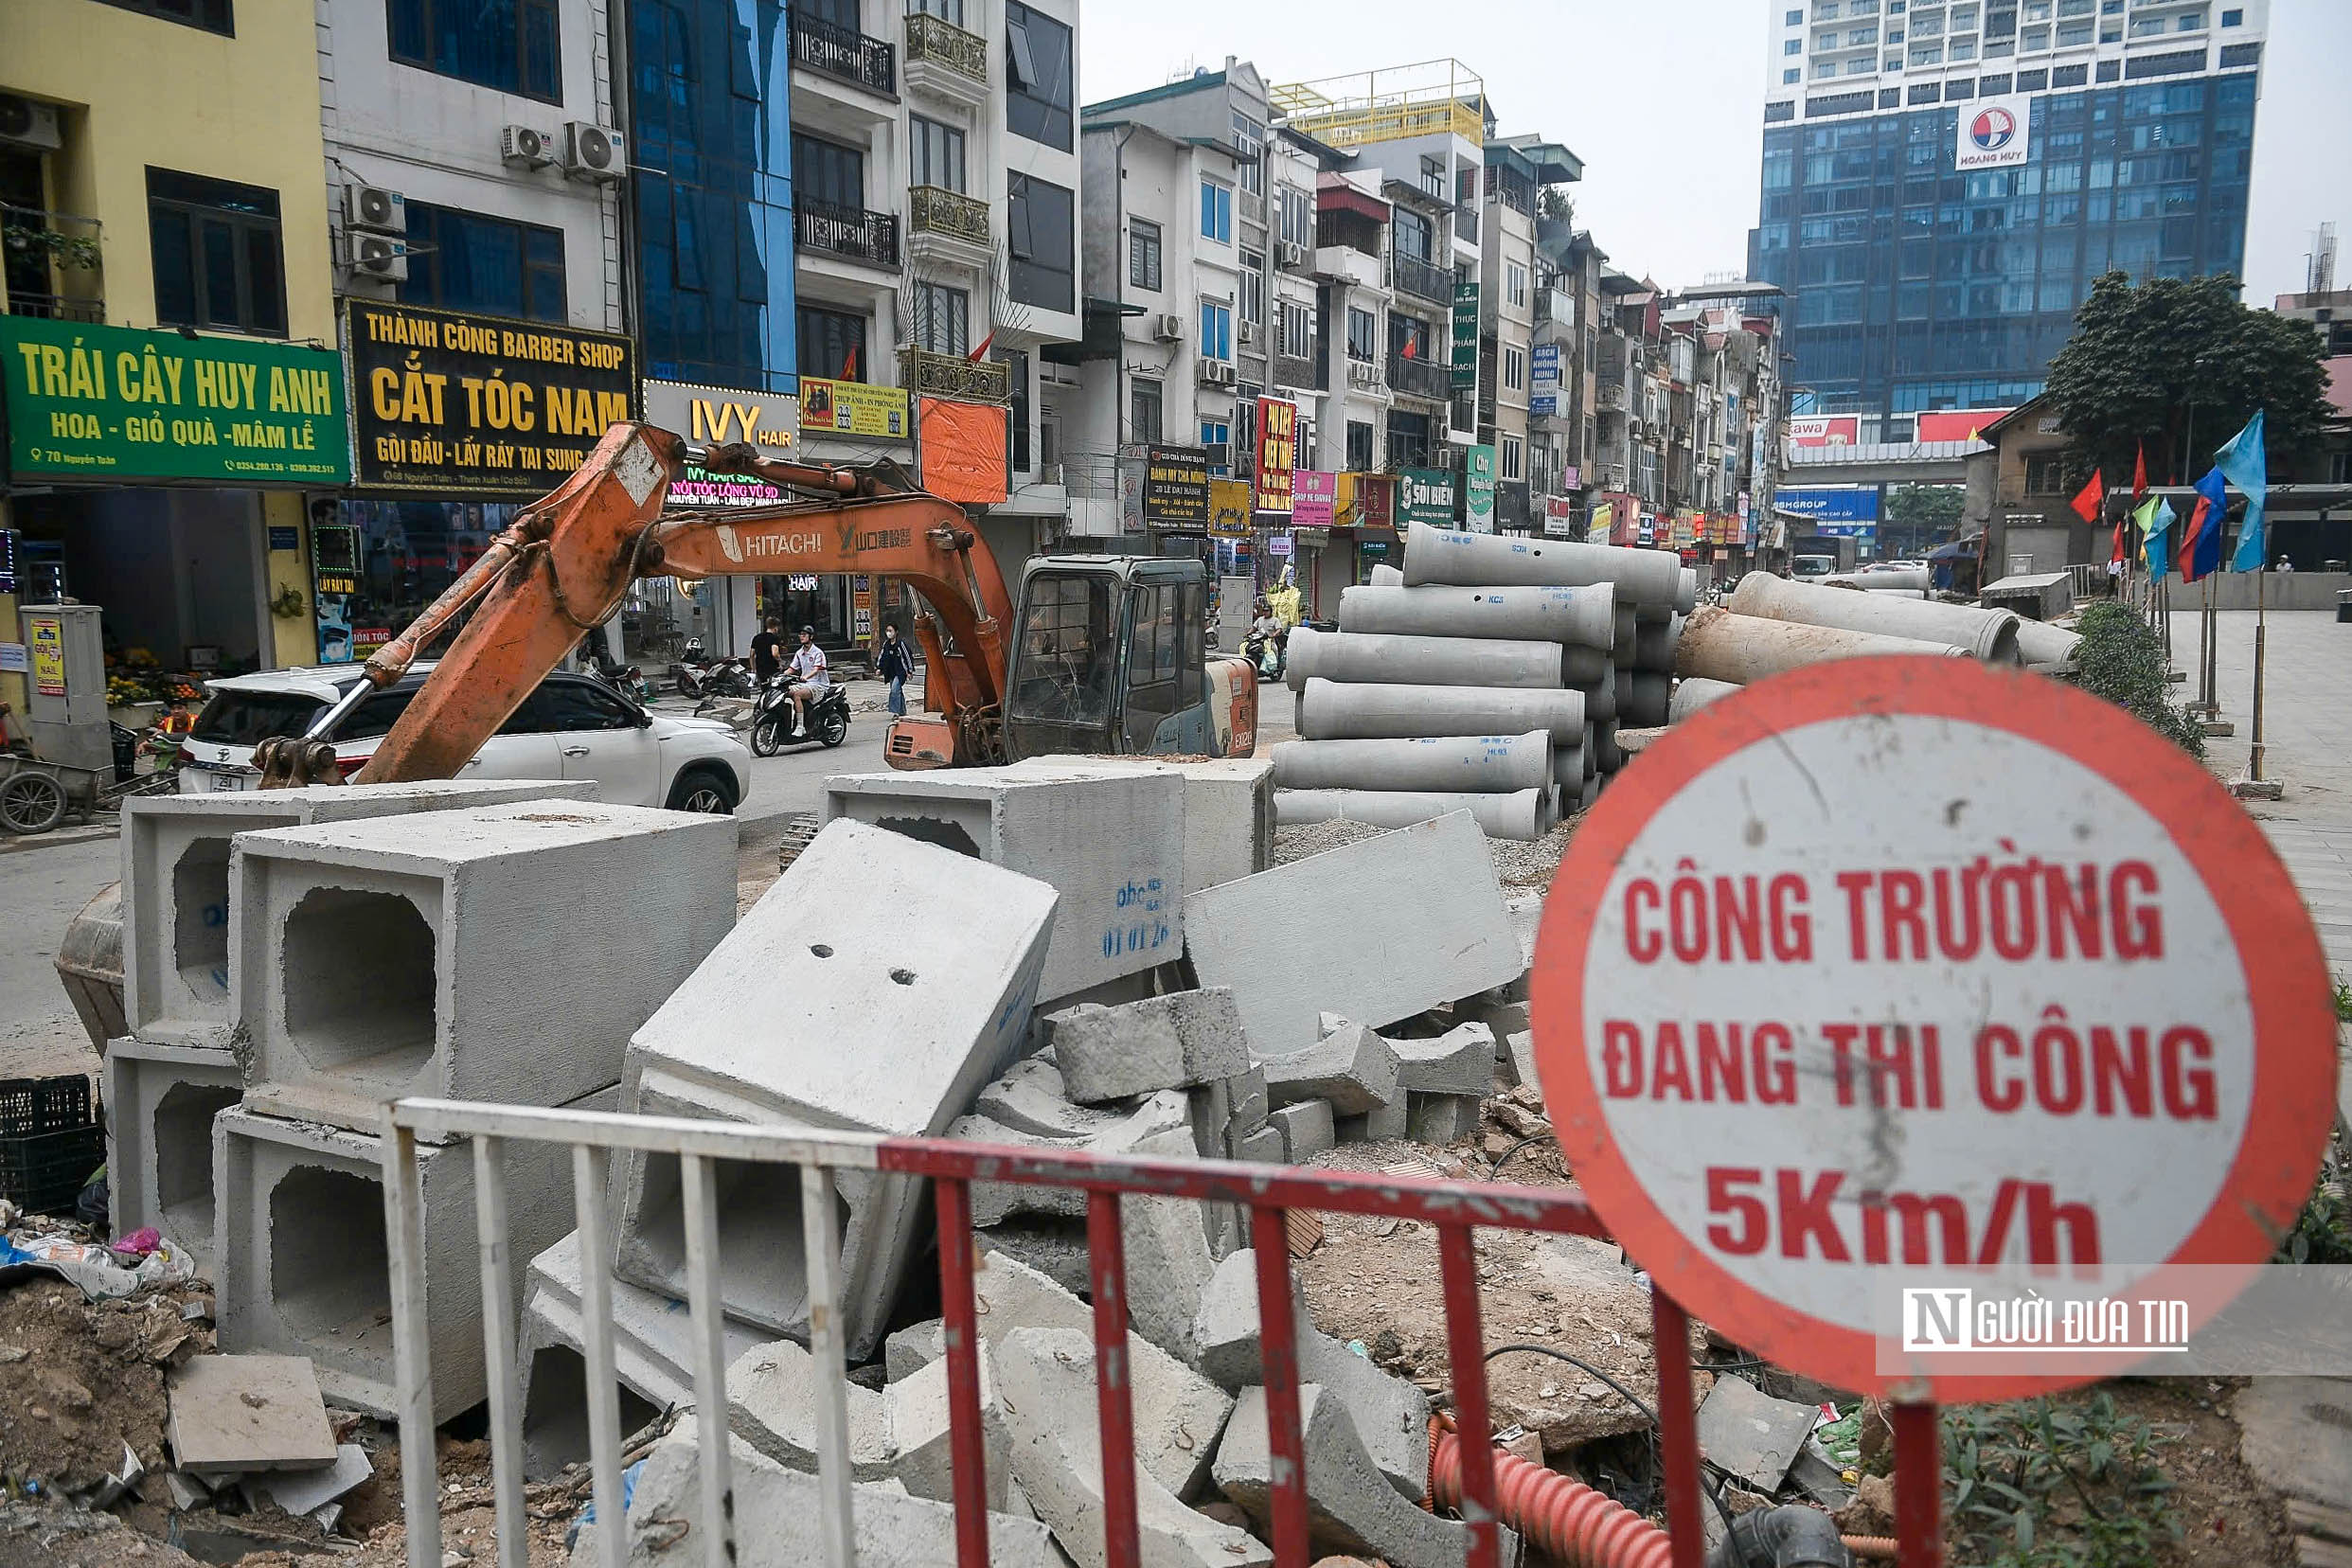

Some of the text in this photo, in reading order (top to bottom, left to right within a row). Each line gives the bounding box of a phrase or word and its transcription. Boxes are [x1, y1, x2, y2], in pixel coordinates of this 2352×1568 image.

[2000, 151, 2022, 161] HUY
[366, 312, 624, 370] THÀNH CÔNG BARBER SHOP
[18, 337, 331, 416] TRÁI CÂY HUY ANH
[371, 350, 628, 437] CẮT TÓC NAM
[50, 412, 101, 439] HOA
[125, 409, 165, 443] GIỎ
[172, 416, 218, 447] QUÀ
[292, 419, 314, 450] LỄ
[690, 399, 791, 448] IVY HAIR
[45, 450, 61, 463] 70
[377, 432, 406, 469] GỘI
[411, 432, 443, 465] ĐẦU
[519, 446, 542, 470] TAI
[687, 467, 705, 481] IVY
[765, 487, 779, 499] 9D
[1413, 478, 1430, 505] SÓI
[745, 532, 822, 557] HITACHI
[790, 576, 817, 591] HAIR
[1488, 596, 1504, 604] KCS
[1623, 838, 2165, 965] CÔNG TRƯỜNG
[1602, 1004, 2219, 1121] ĐANG THI CÔNG
[1706, 1166, 2104, 1282] 5Km/h
